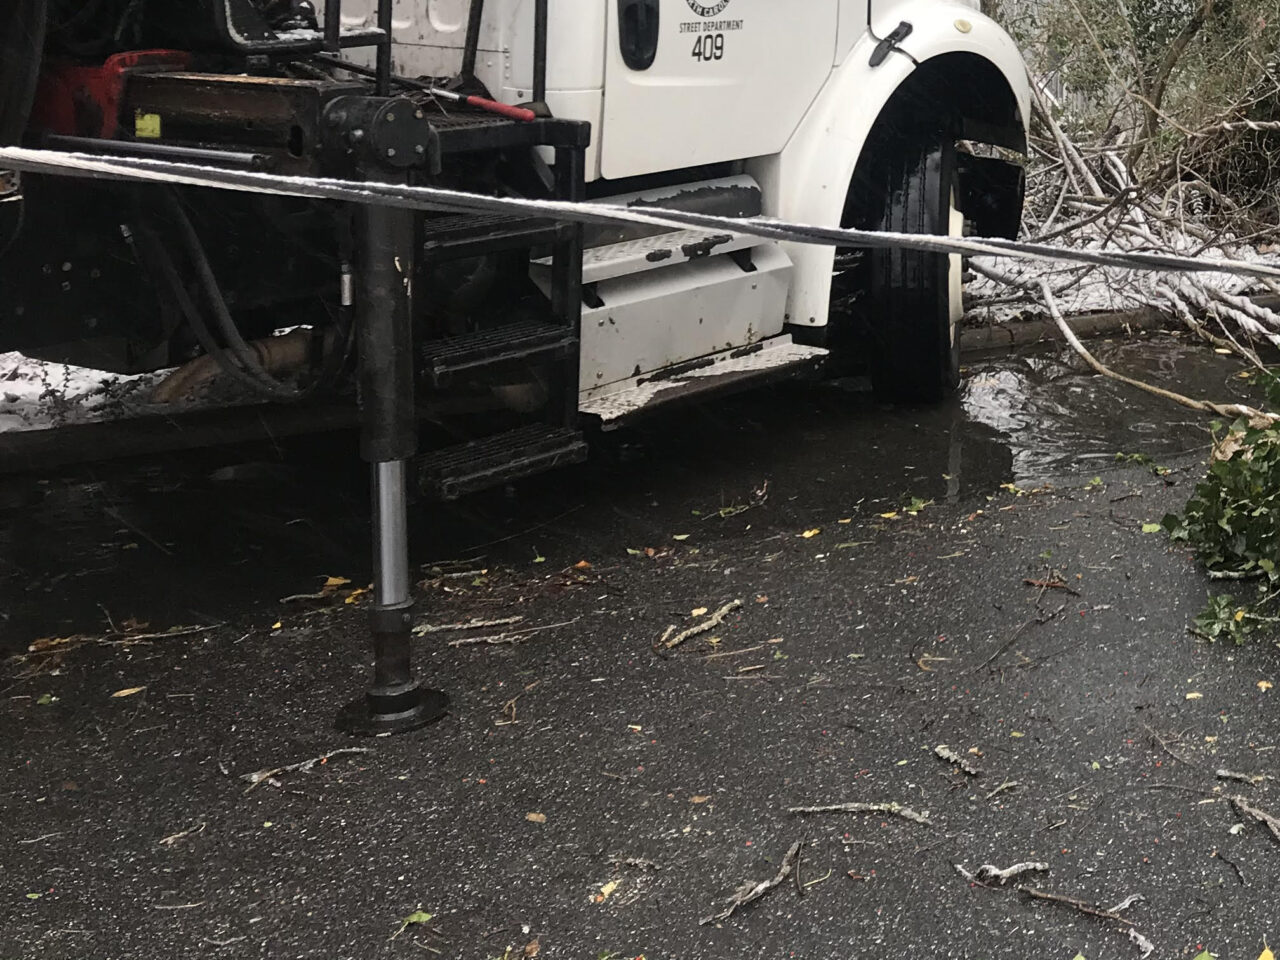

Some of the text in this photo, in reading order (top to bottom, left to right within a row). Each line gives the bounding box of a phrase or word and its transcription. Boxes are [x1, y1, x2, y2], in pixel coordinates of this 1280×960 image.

[679, 19, 743, 33] STREET DEPARTMENT
[692, 33, 724, 62] 409
